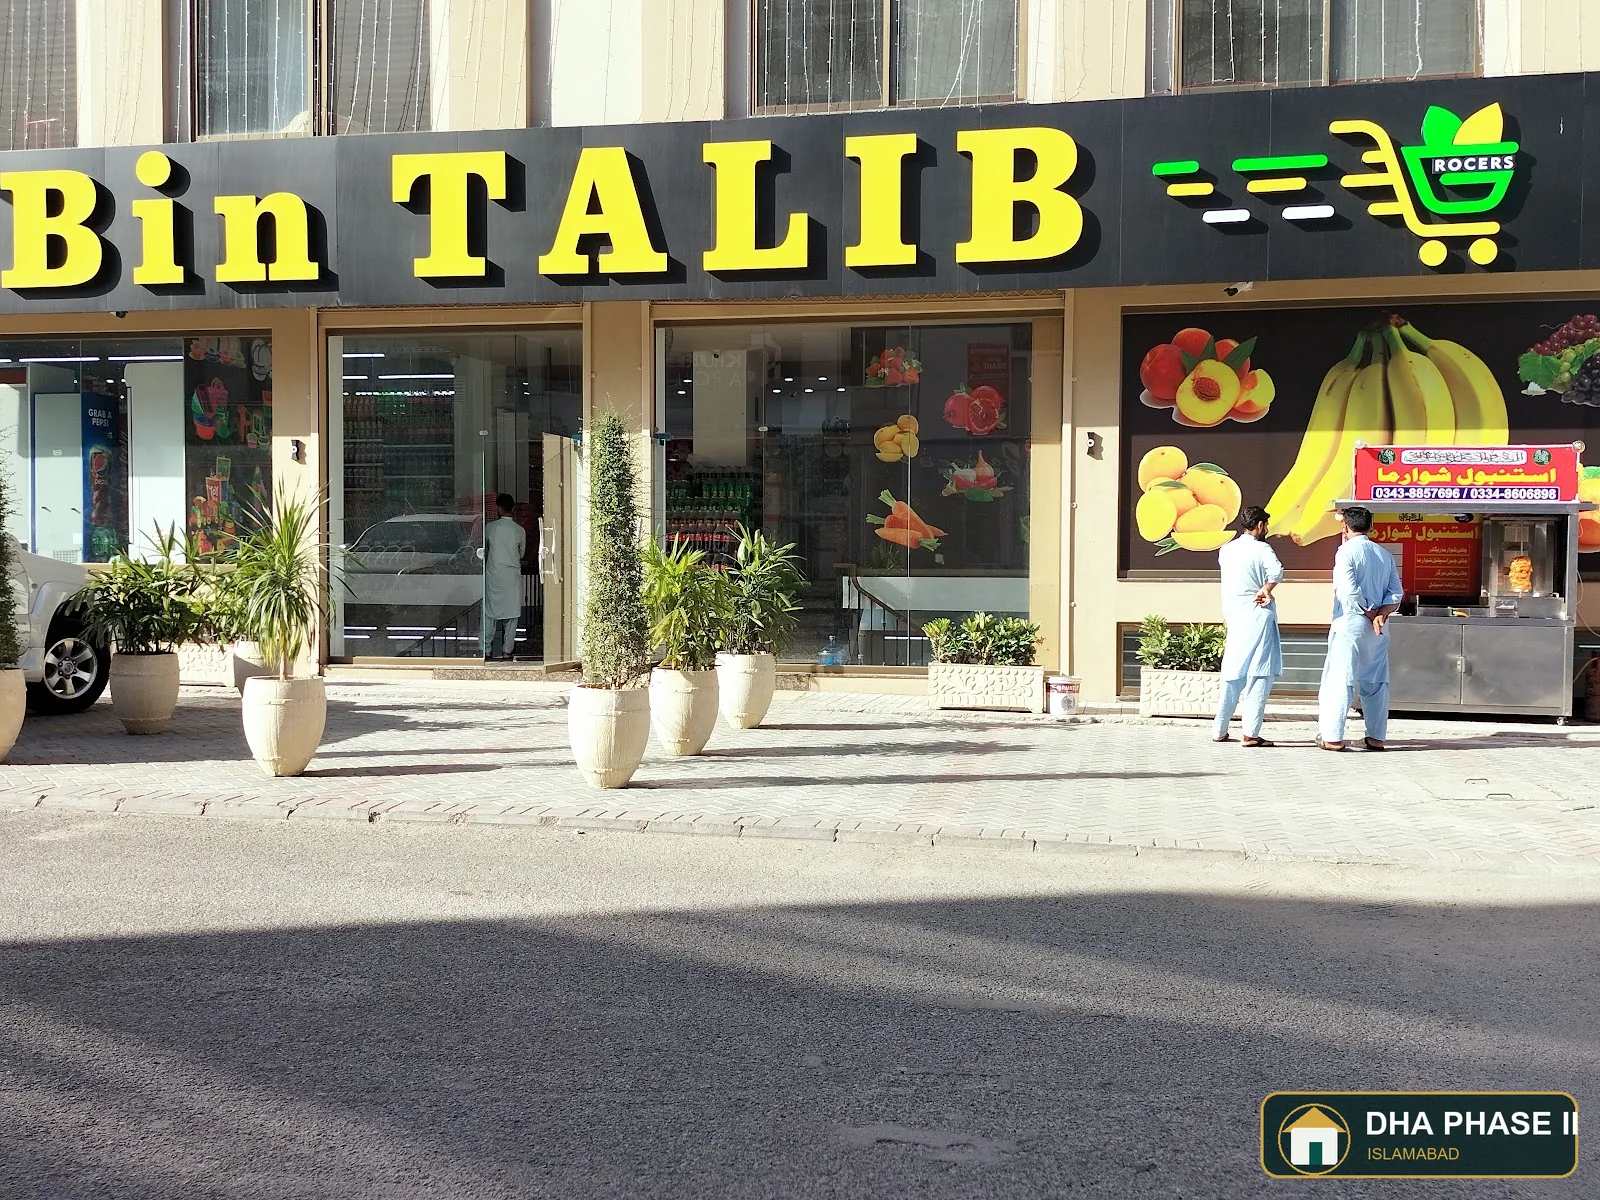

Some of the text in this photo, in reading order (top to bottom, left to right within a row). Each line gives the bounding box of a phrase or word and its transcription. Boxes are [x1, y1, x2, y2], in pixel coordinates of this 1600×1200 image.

[1434, 155, 1515, 172] ROCERS
[0, 127, 1084, 289] Bin TALIB
[88, 408, 113, 419] GRAB A
[92, 418, 109, 427] PEPSI
[1377, 466, 1557, 486] استنبول شوارما
[1375, 487, 1460, 499] 0343-8857696
[1470, 487, 1557, 499] 0334-8606898
[1367, 525, 1412, 541] شوارم
